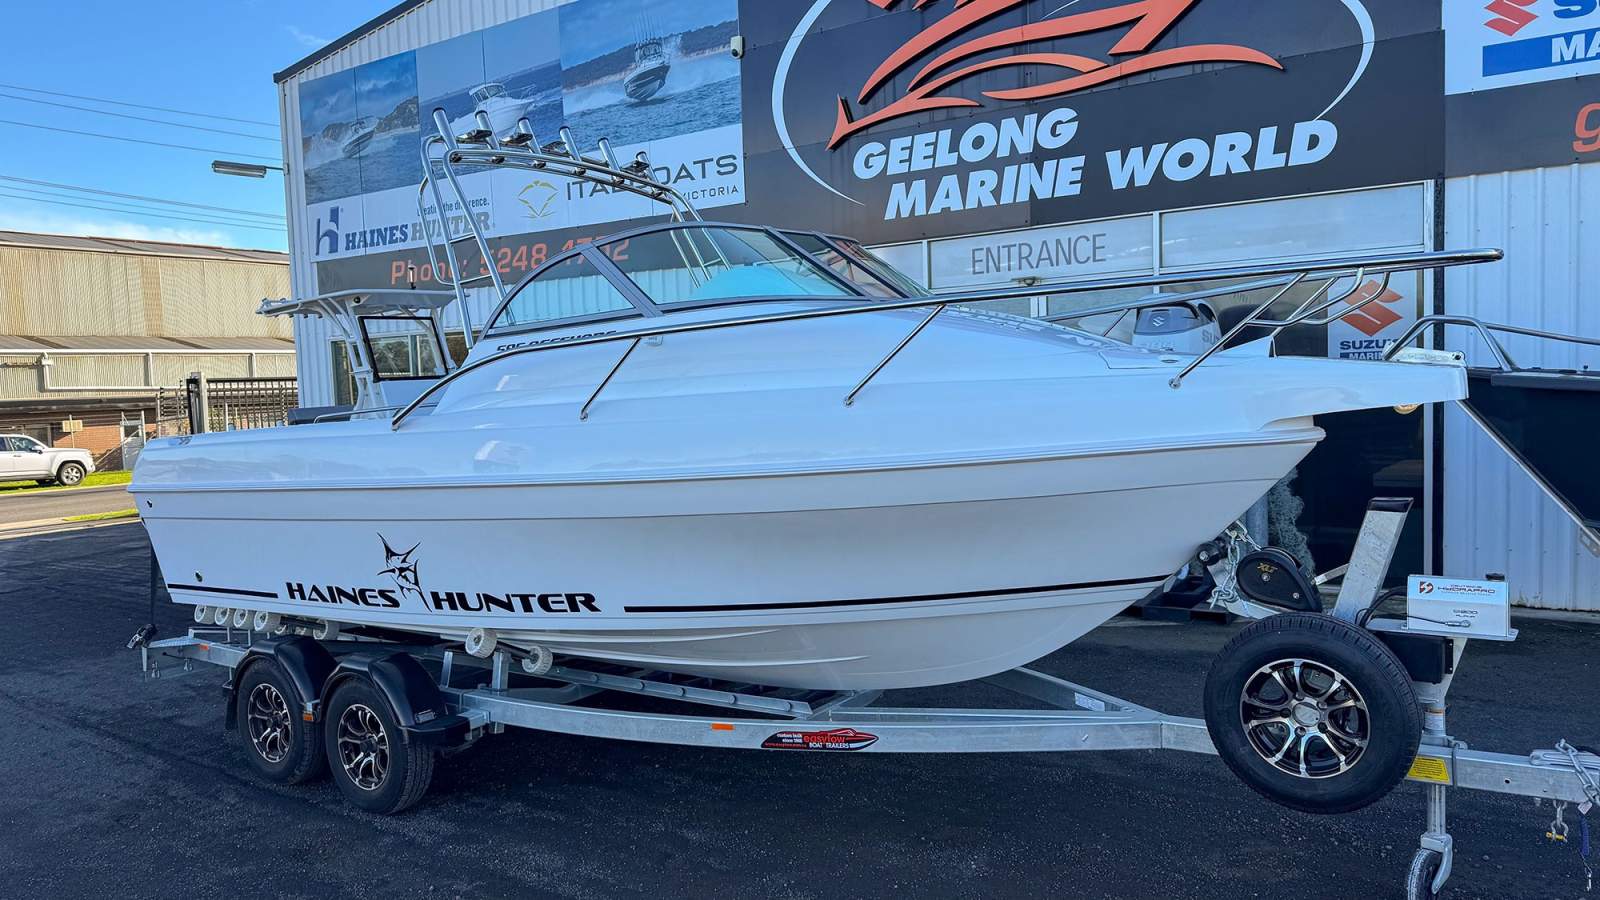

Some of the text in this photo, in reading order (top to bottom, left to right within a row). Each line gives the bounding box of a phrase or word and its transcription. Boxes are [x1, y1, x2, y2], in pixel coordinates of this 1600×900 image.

[853, 107, 1079, 180] GEELONG
[884, 119, 1338, 221] MARINE WORLD
[345, 224, 409, 251] HAINES
[561, 235, 630, 265] 472
[972, 232, 1107, 276] ENTRANCE
[1340, 339, 1398, 350] SUZU
[286, 582, 602, 613] HAINES HUNTER
